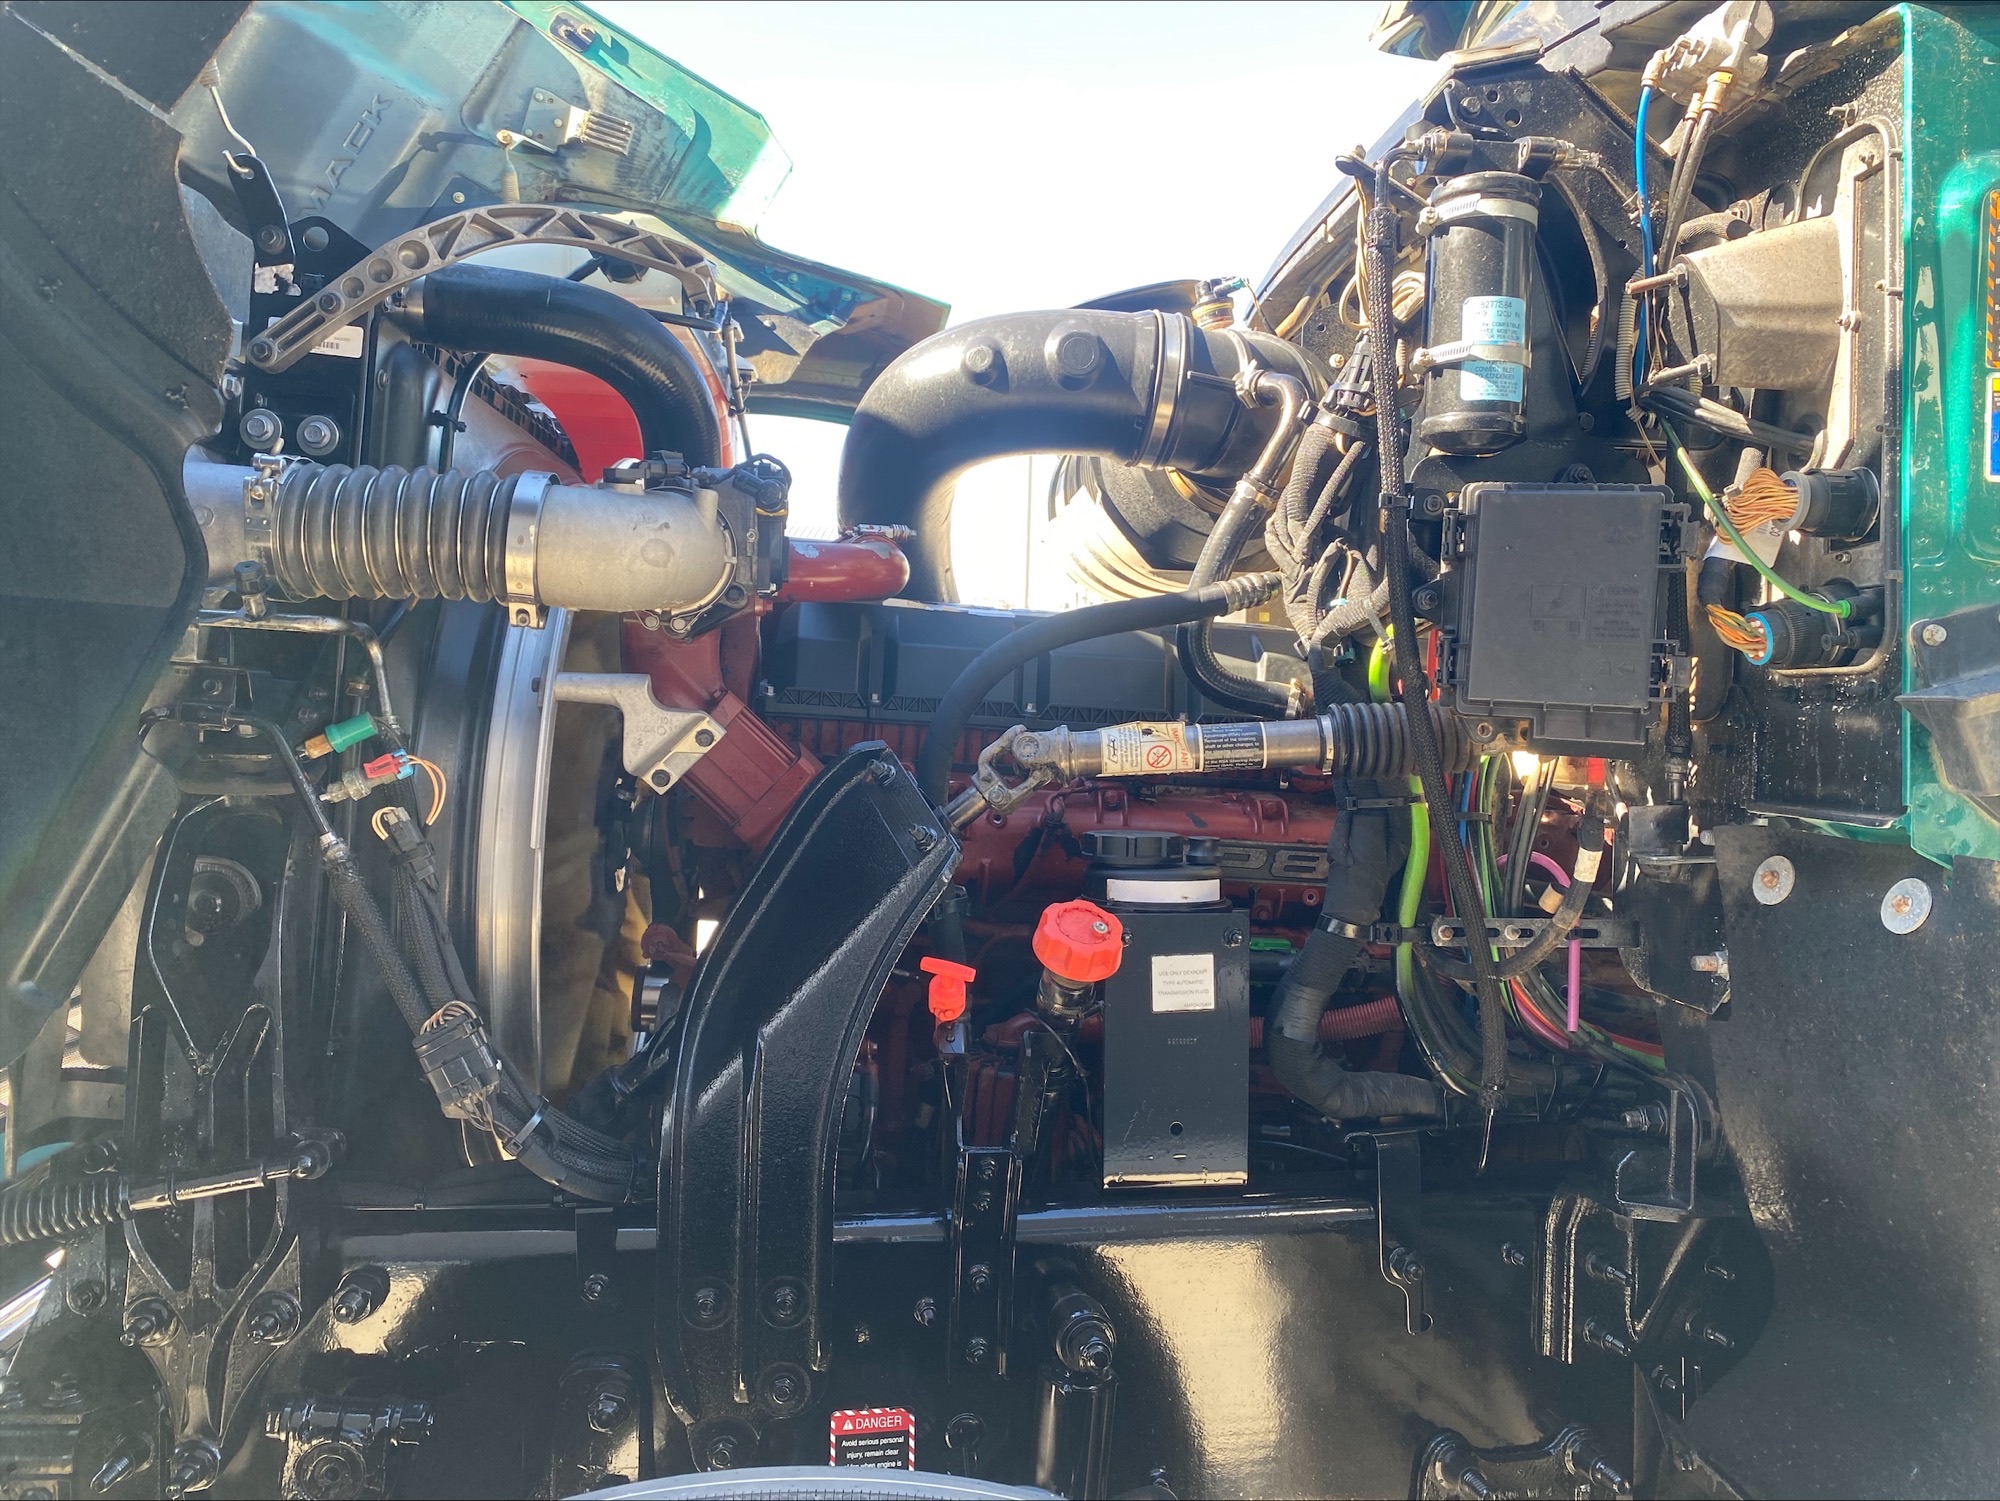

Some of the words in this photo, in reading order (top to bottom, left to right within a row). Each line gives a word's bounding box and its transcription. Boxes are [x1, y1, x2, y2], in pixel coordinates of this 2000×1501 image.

[297, 94, 393, 217] MACK
[856, 1416, 902, 1430] DANGER
[880, 1436, 904, 1446] personal
[847, 1451, 863, 1460] injury,
[877, 1460, 896, 1469] engine
